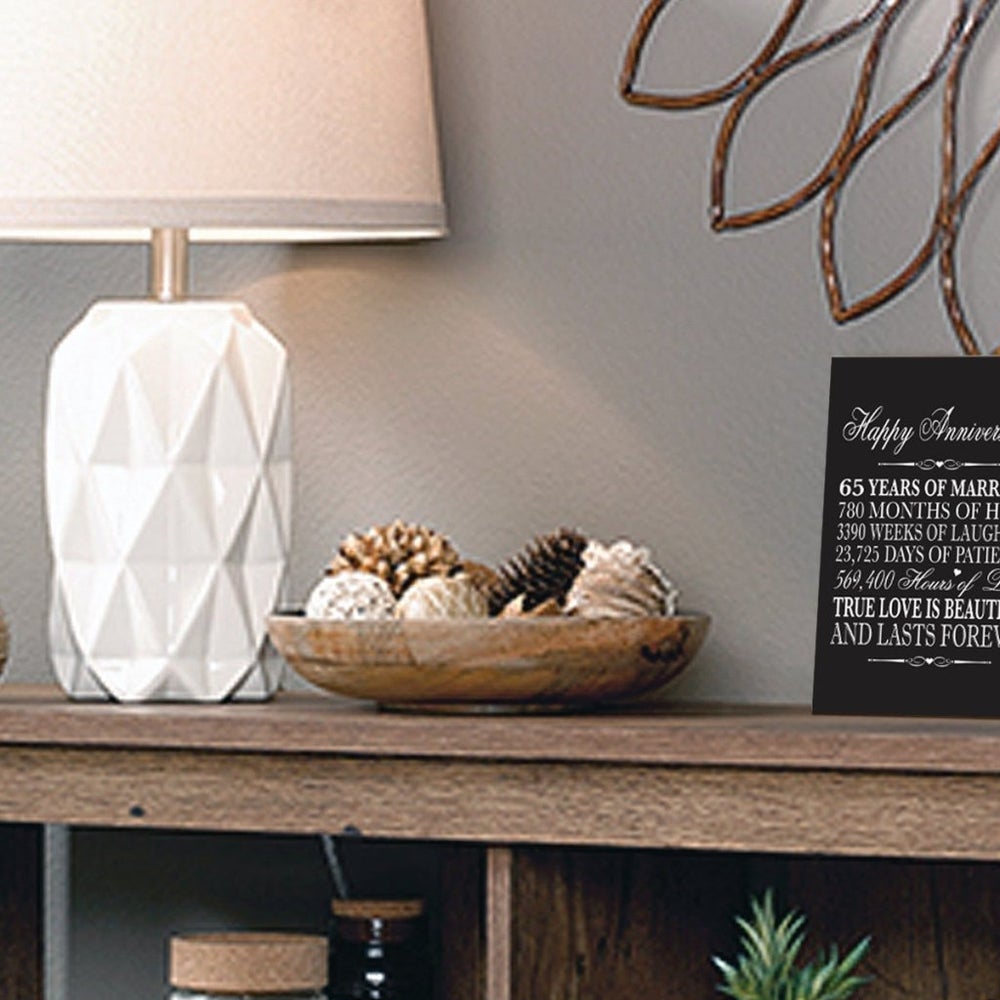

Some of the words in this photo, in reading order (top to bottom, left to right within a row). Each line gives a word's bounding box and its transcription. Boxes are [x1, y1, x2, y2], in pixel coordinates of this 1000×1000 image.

[842, 405, 915, 456] Happy
[839, 478, 865, 497] 65
[868, 478, 921, 497] YEARS
[924, 478, 948, 498] OF
[838, 501, 865, 519] 780
[868, 501, 951, 520] MONTHS
[955, 501, 982, 520] OF
[836, 522, 866, 541] 3390
[870, 523, 923, 541] WEEKS
[926, 523, 948, 542] OF
[835, 544, 880, 566] 23,725
[884, 545, 925, 563] DAYS
[928, 545, 951, 564] OF
[897, 567, 955, 591] Hours
[956, 571, 983, 598] of
[833, 596, 876, 618] TRUE
[878, 597, 923, 619] LOVE
[925, 597, 941, 620] IS
[830, 621, 873, 646] AND
[876, 622, 936, 647] LASTS
